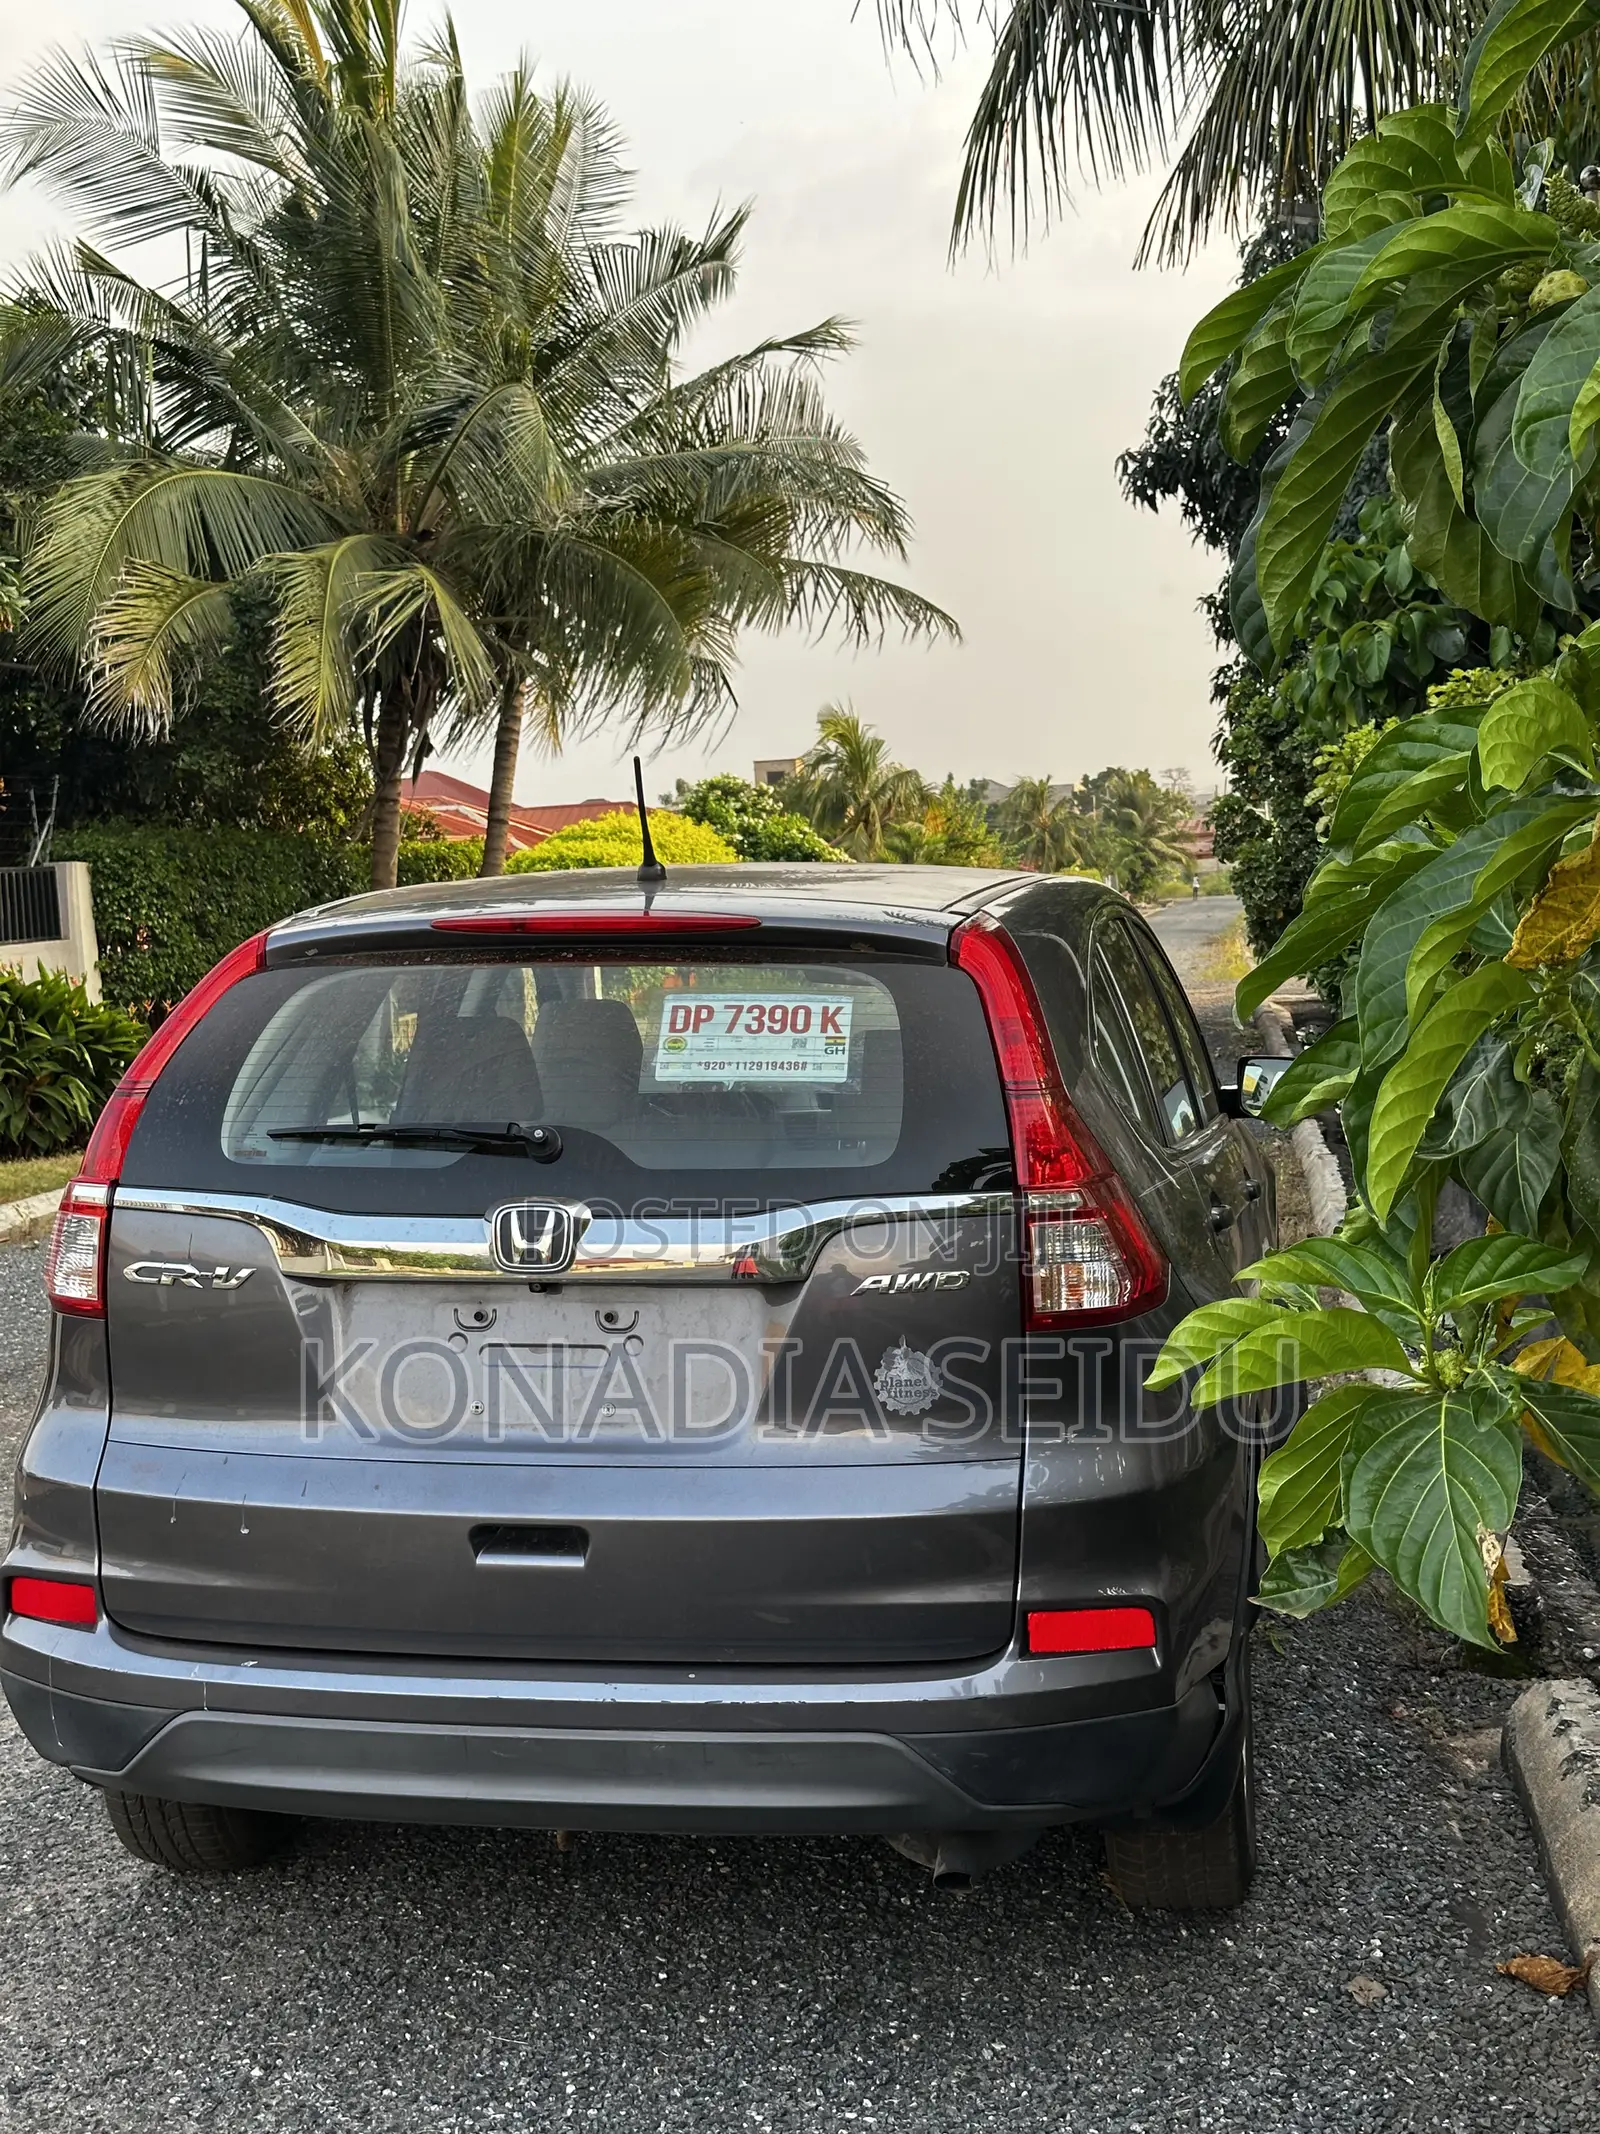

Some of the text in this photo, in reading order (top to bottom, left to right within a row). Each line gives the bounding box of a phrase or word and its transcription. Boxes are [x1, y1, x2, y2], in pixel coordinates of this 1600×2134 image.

[668, 1004, 845, 1035] DP 7390 K
[824, 1046, 846, 1055] GH
[122, 1260, 258, 1290] CR-V
[850, 1269, 971, 1297] AWD
[880, 1376, 928, 1391] planet
[888, 1387, 938, 1399] fitness
